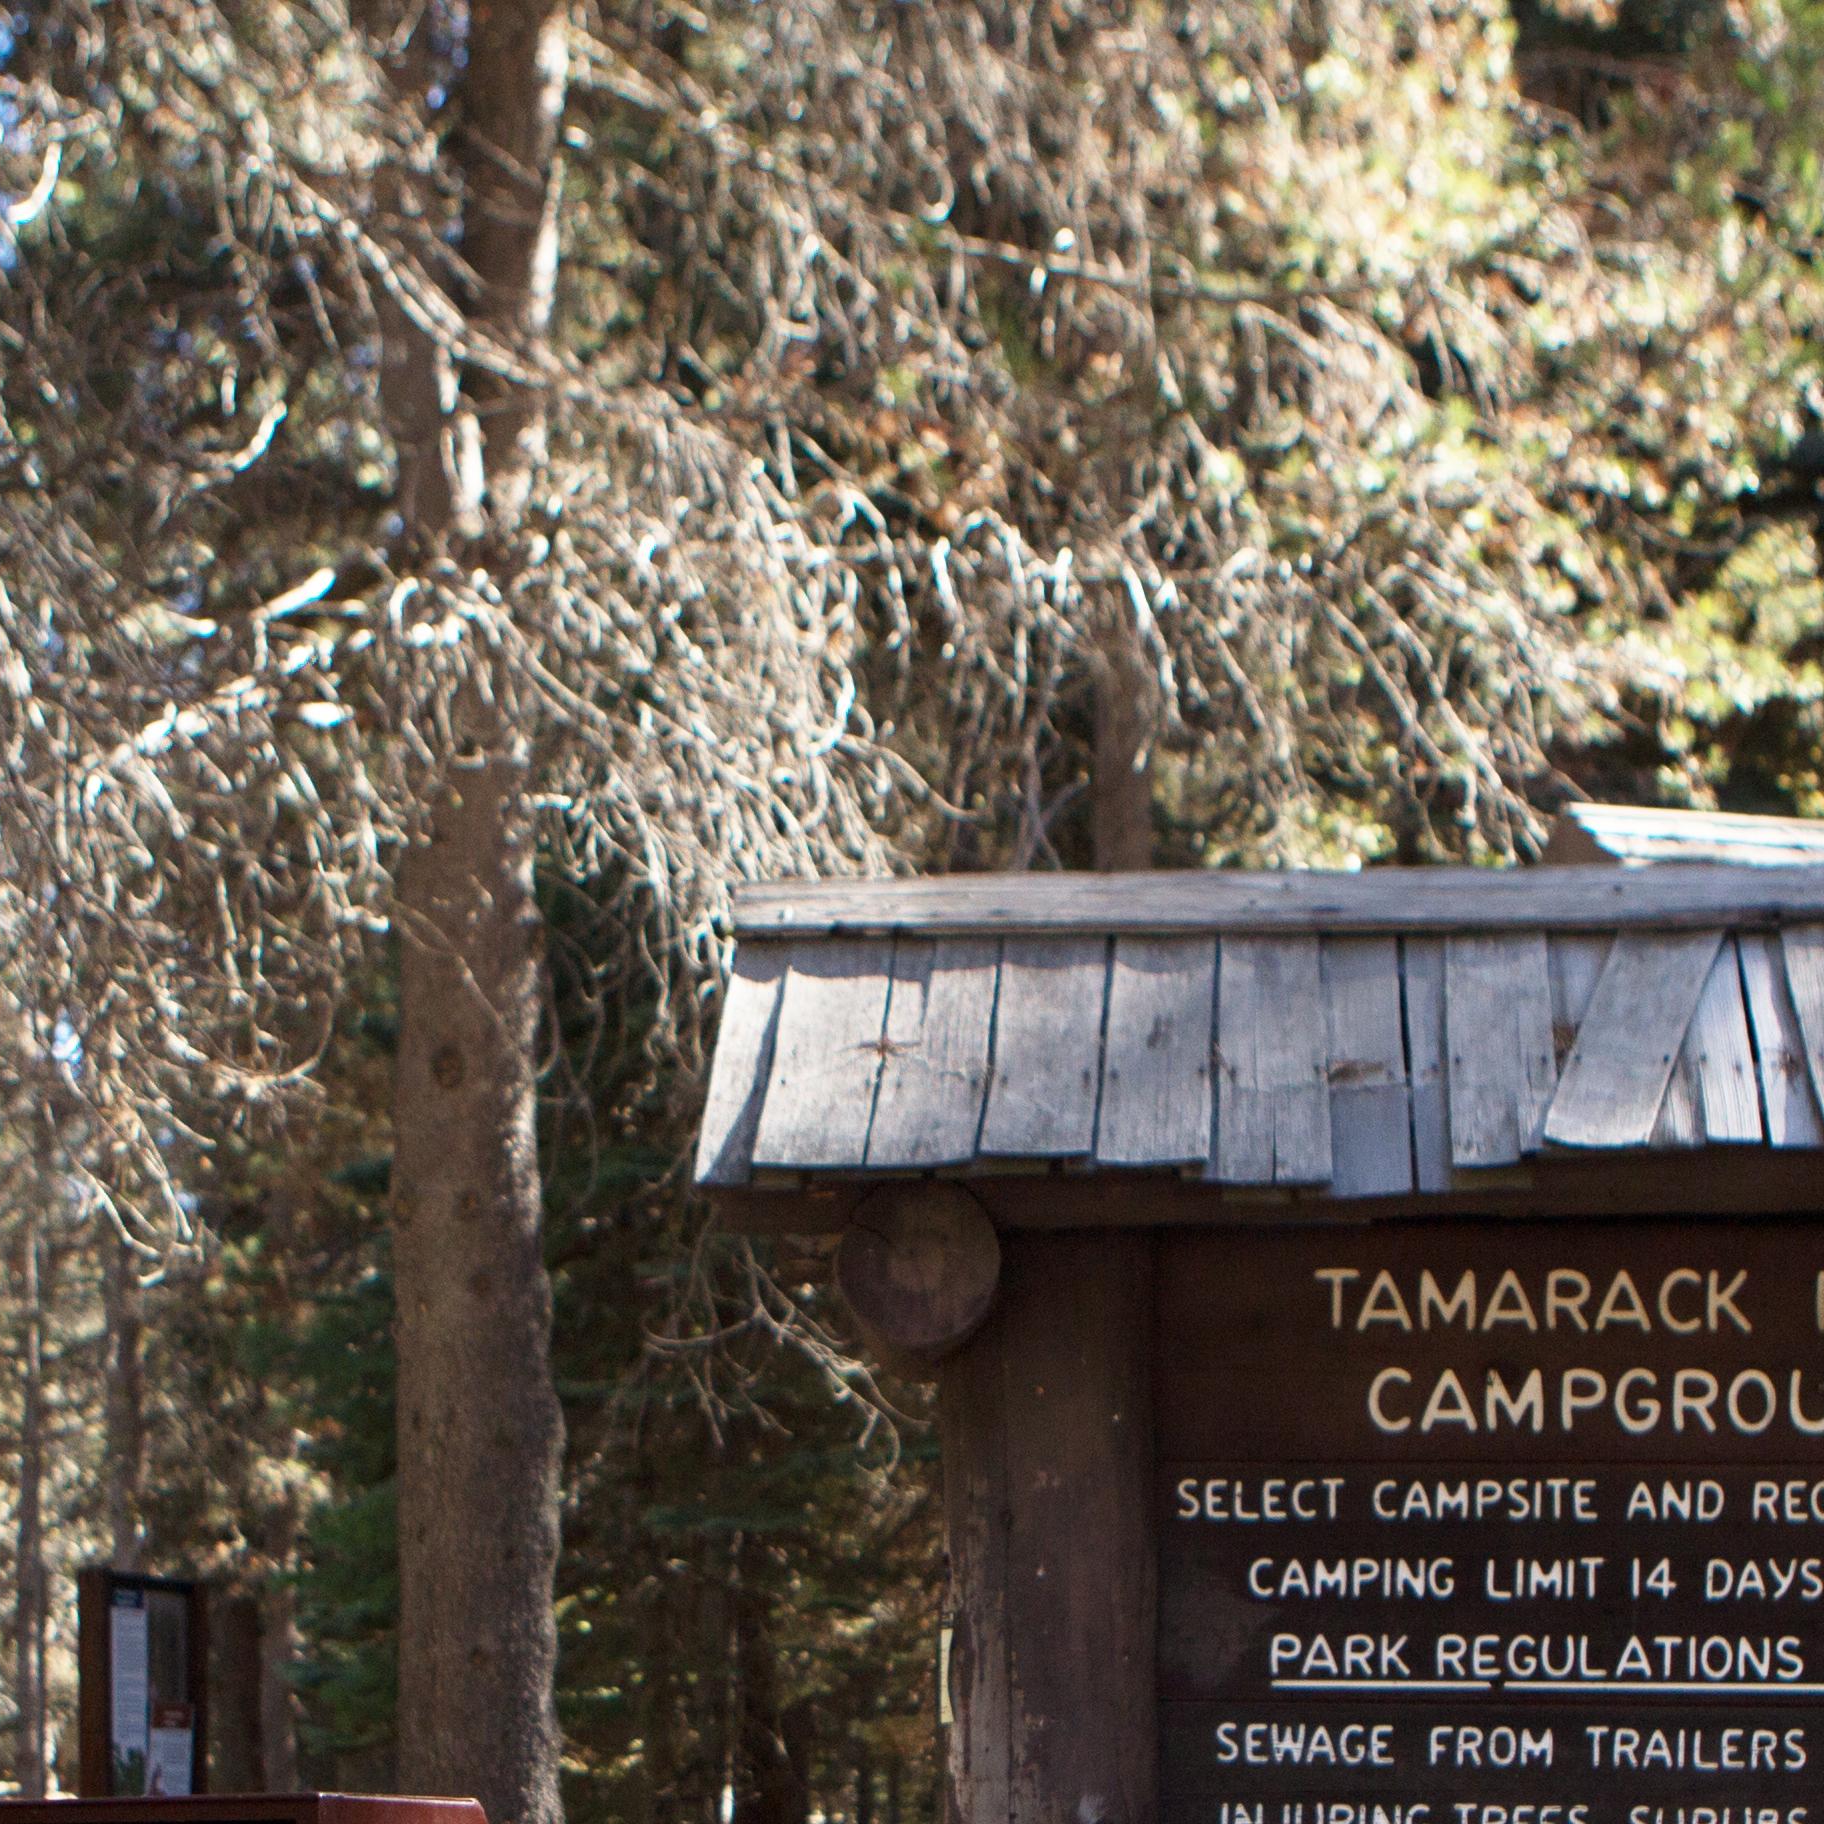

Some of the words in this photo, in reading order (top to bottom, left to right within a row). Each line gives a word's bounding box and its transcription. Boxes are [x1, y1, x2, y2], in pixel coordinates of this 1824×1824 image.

[1316, 1268, 1751, 1332] TAMARACK
[1178, 1478, 1344, 1520] SELECT
[1374, 1478, 1597, 1520] CAMPSITE
[1628, 1480, 1724, 1520] AND
[1250, 1558, 1454, 1597] CAMPING
[1487, 1557, 1604, 1600] LIMIT
[1632, 1558, 1676, 1597] 14
[1706, 1559, 1823, 1599] DAYS
[1271, 1634, 1409, 1674] PARK
[1437, 1634, 1803, 1680] REGULATIONS
[1217, 1723, 1393, 1764] SEWAGE
[1430, 1726, 1553, 1766] FROM
[1587, 1726, 1806, 1770] TRAILERS
